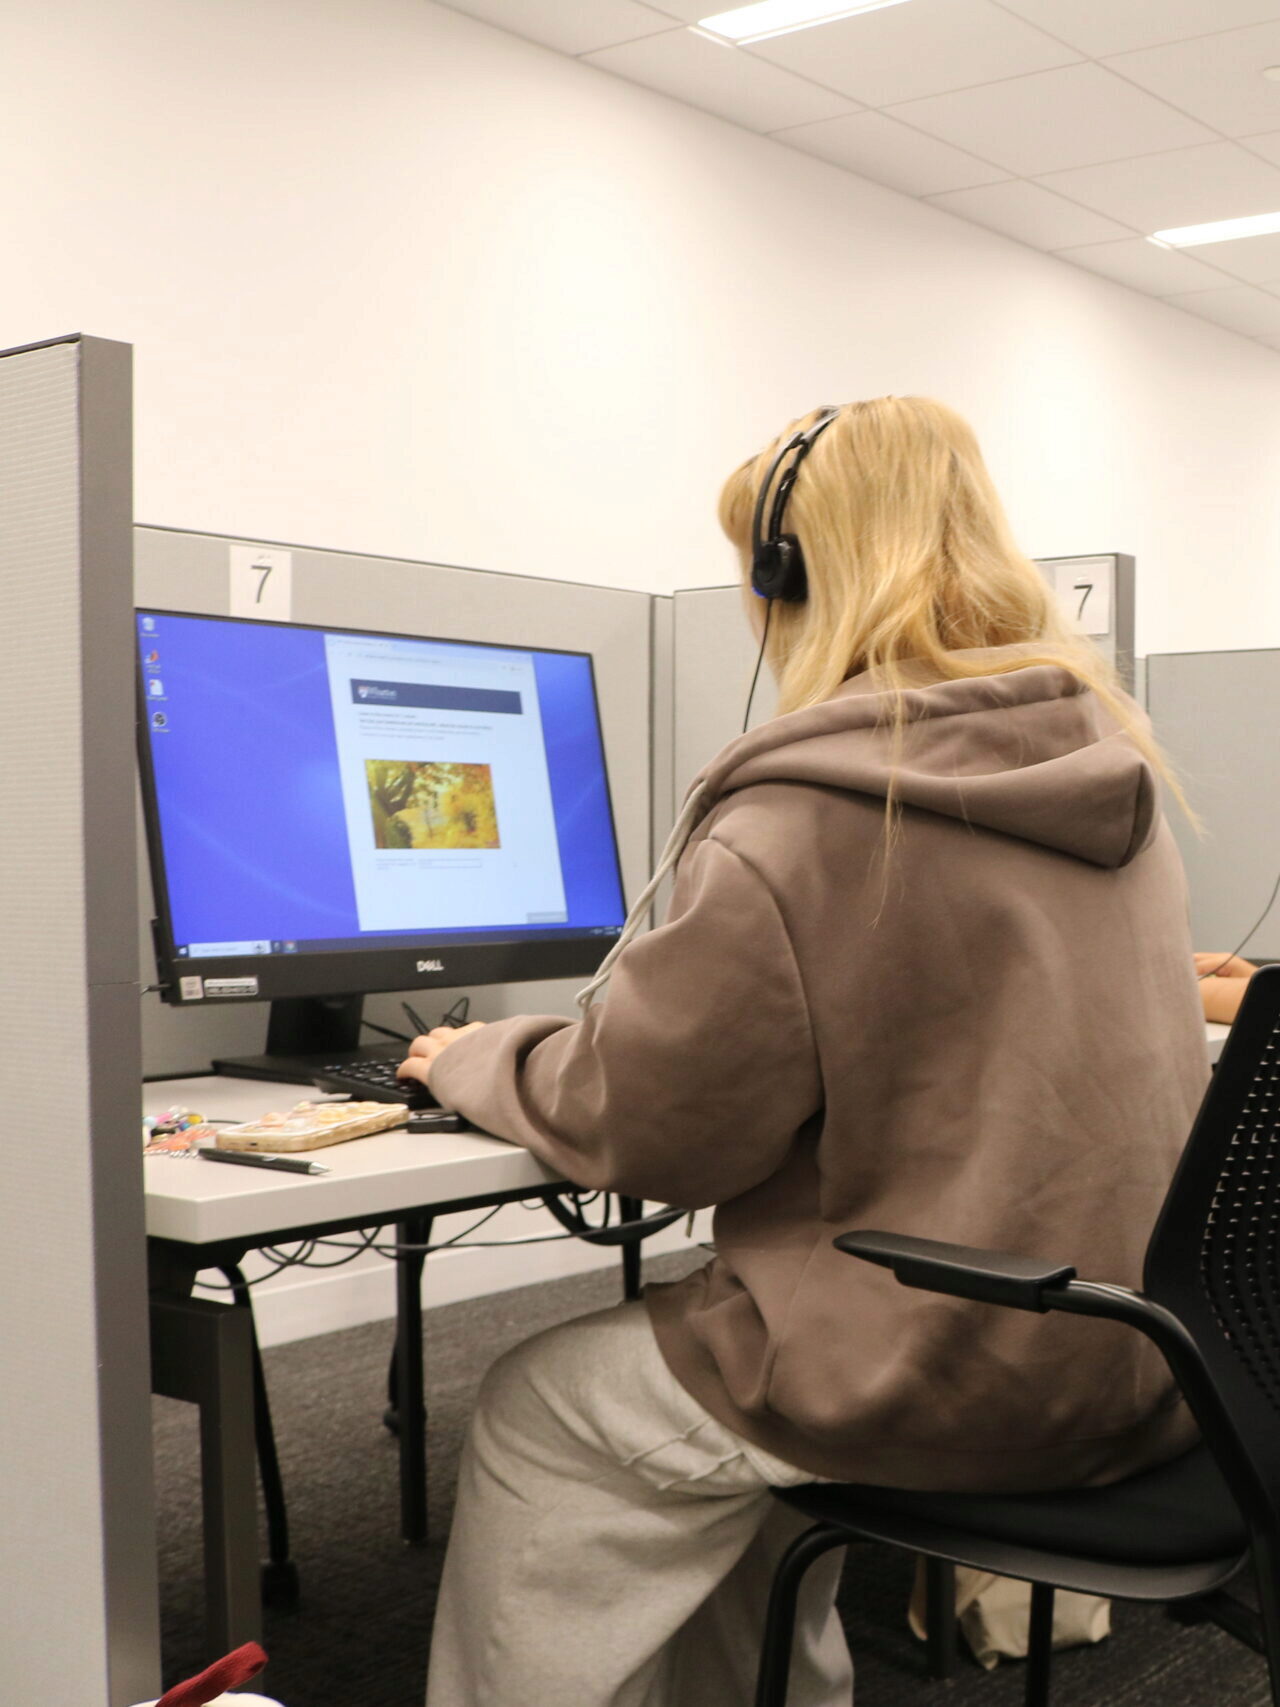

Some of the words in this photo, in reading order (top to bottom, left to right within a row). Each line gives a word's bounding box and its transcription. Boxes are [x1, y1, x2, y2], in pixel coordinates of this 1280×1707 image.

[251, 565, 273, 604] 7
[1073, 583, 1094, 621] 7
[415, 958, 445, 973] DELL
